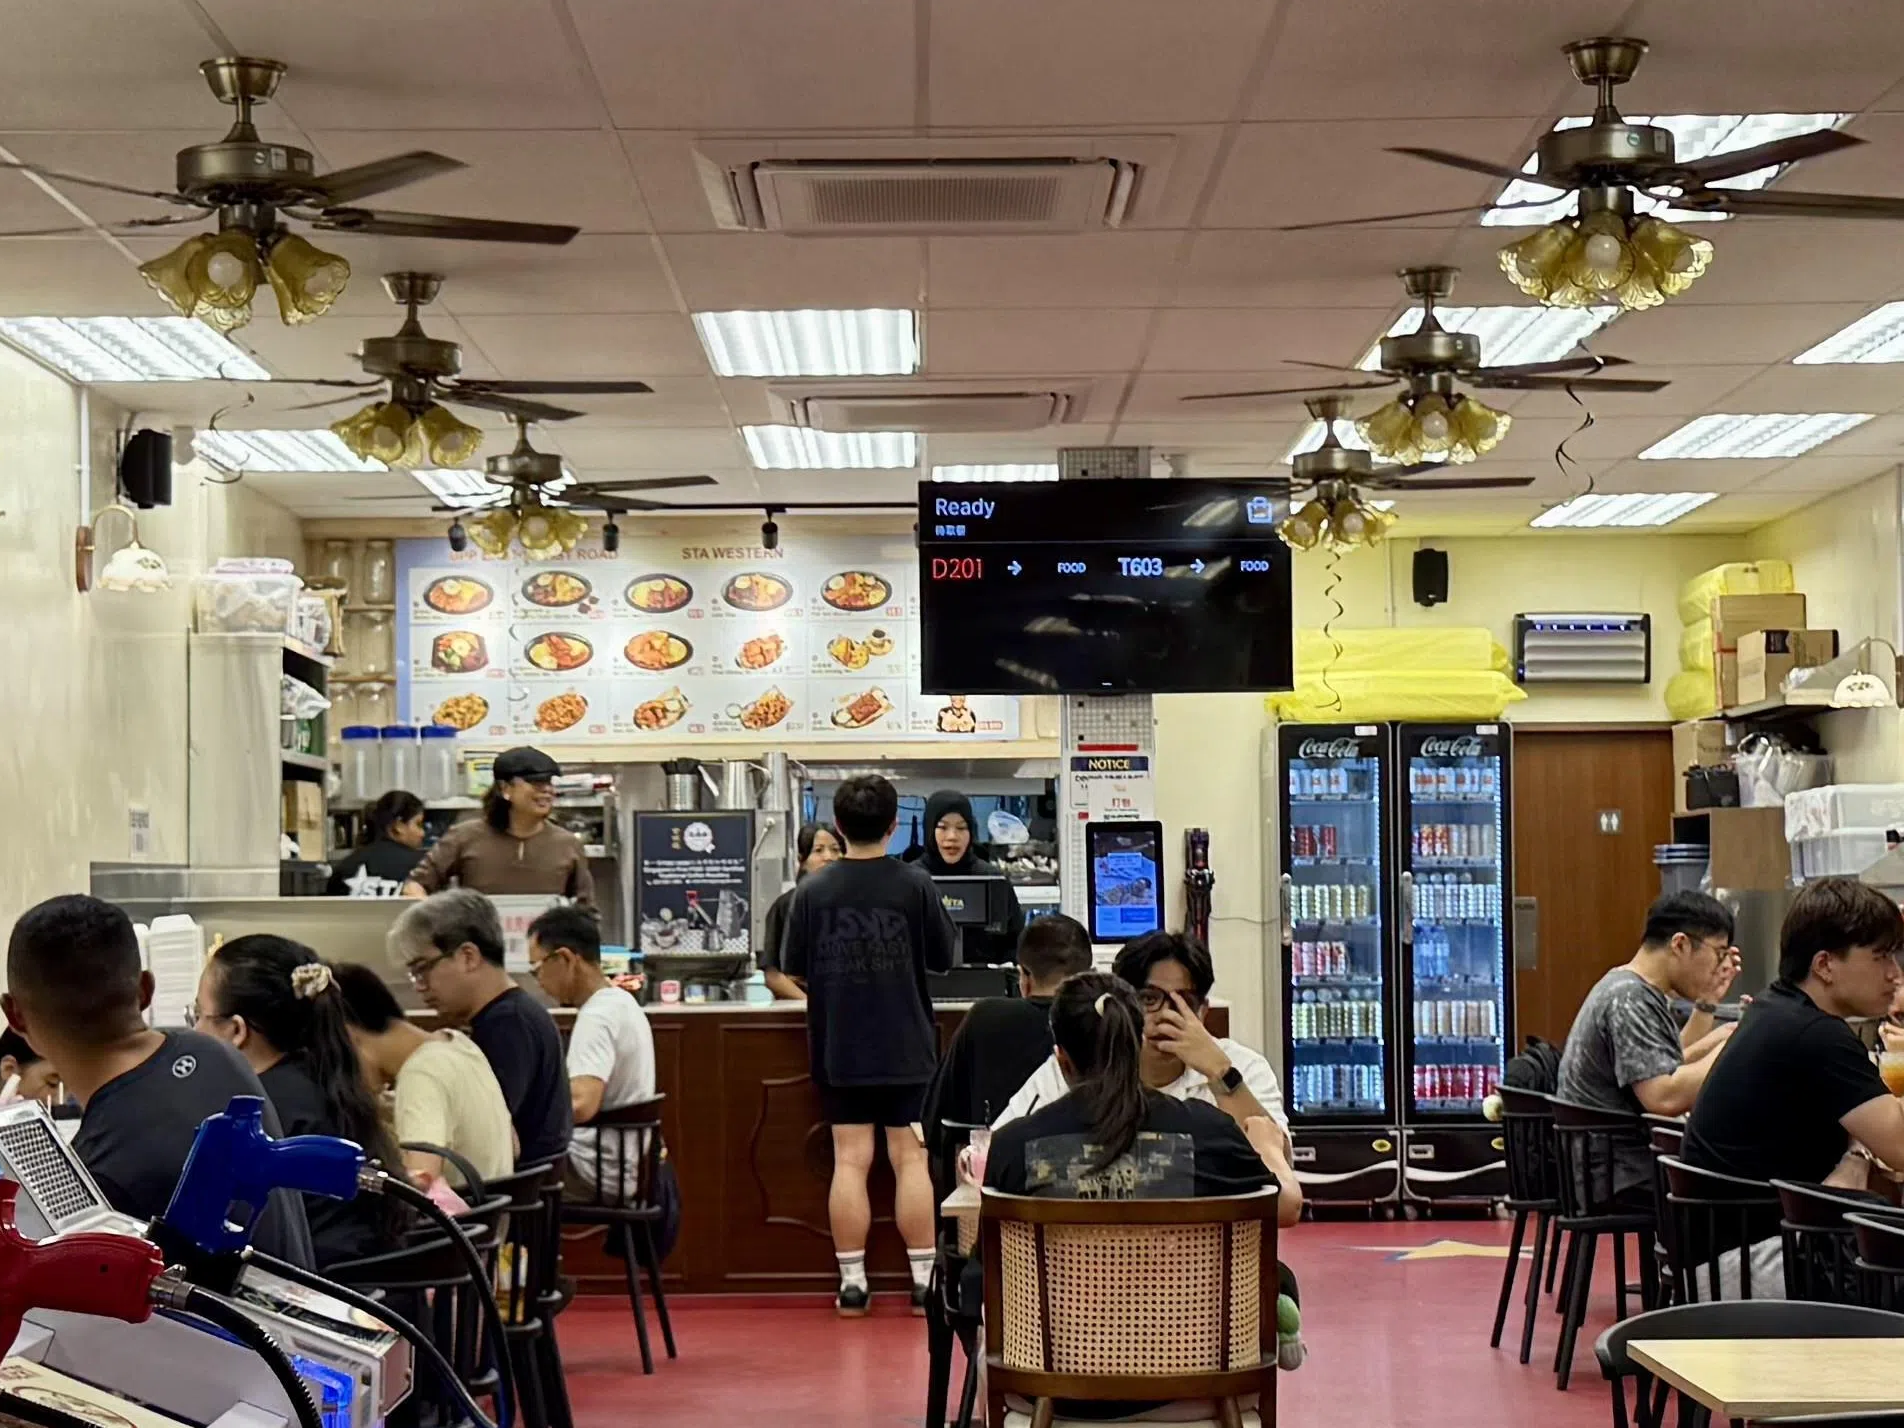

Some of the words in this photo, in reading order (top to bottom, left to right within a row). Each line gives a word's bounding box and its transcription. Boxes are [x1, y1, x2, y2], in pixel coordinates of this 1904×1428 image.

[935, 497, 995, 519] Ready
[681, 547, 710, 560] STA
[713, 546, 784, 560] WESTERN
[932, 558, 983, 579] D201
[1057, 562, 1086, 573] FOOD
[1117, 557, 1163, 577] T603
[1240, 560, 1269, 572] FOOD
[1088, 758, 1130, 770] NOTICE
